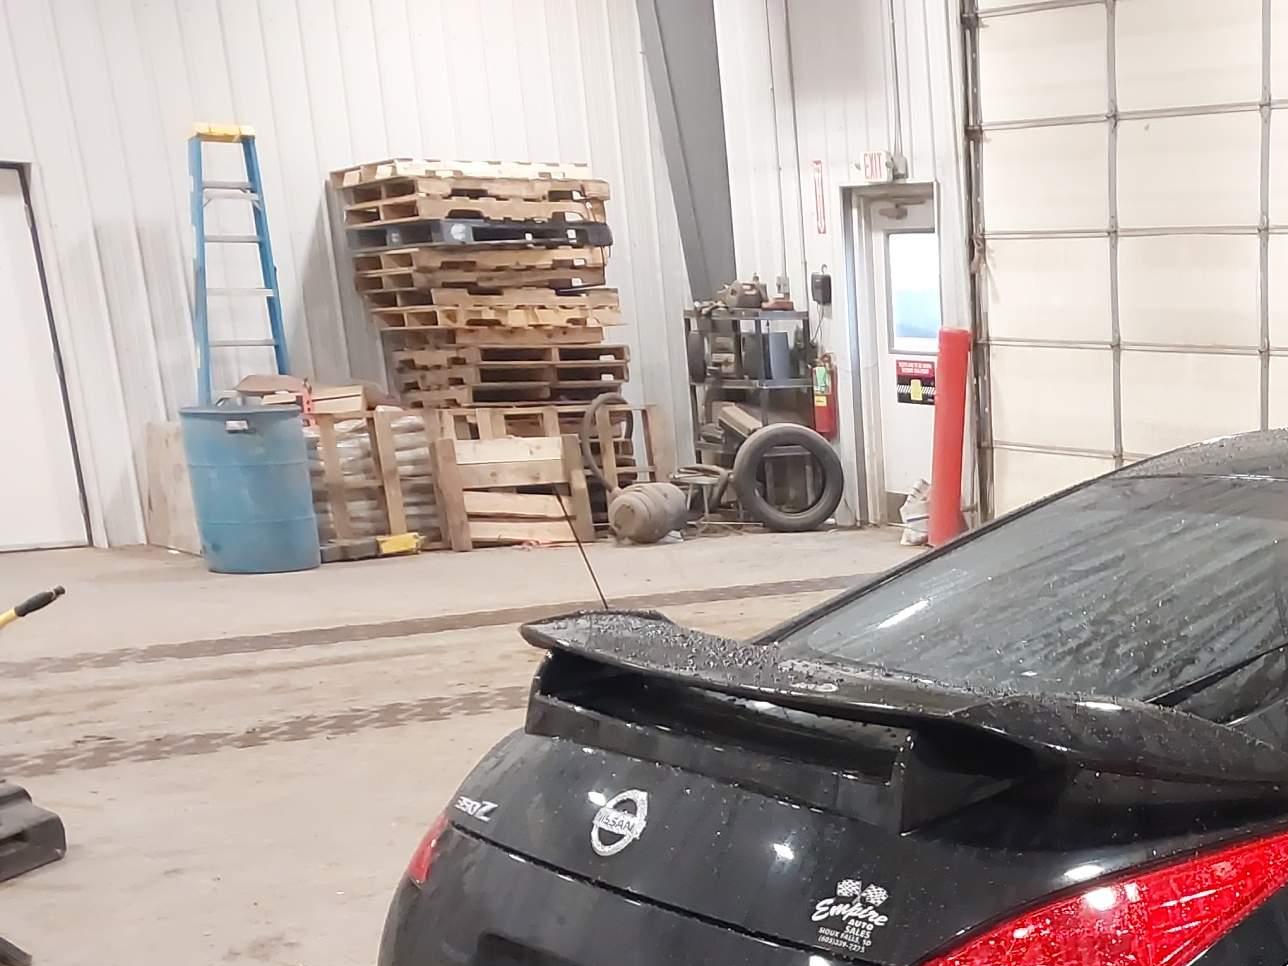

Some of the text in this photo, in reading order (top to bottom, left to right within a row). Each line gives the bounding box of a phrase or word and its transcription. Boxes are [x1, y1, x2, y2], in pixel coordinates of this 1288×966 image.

[863, 152, 882, 180] EXIT
[454, 796, 498, 821] 350Z
[811, 897, 889, 926] Empire
[818, 926, 840, 939] SIOUX
[843, 925, 872, 940] SALES
[847, 918, 875, 932] AUTO
